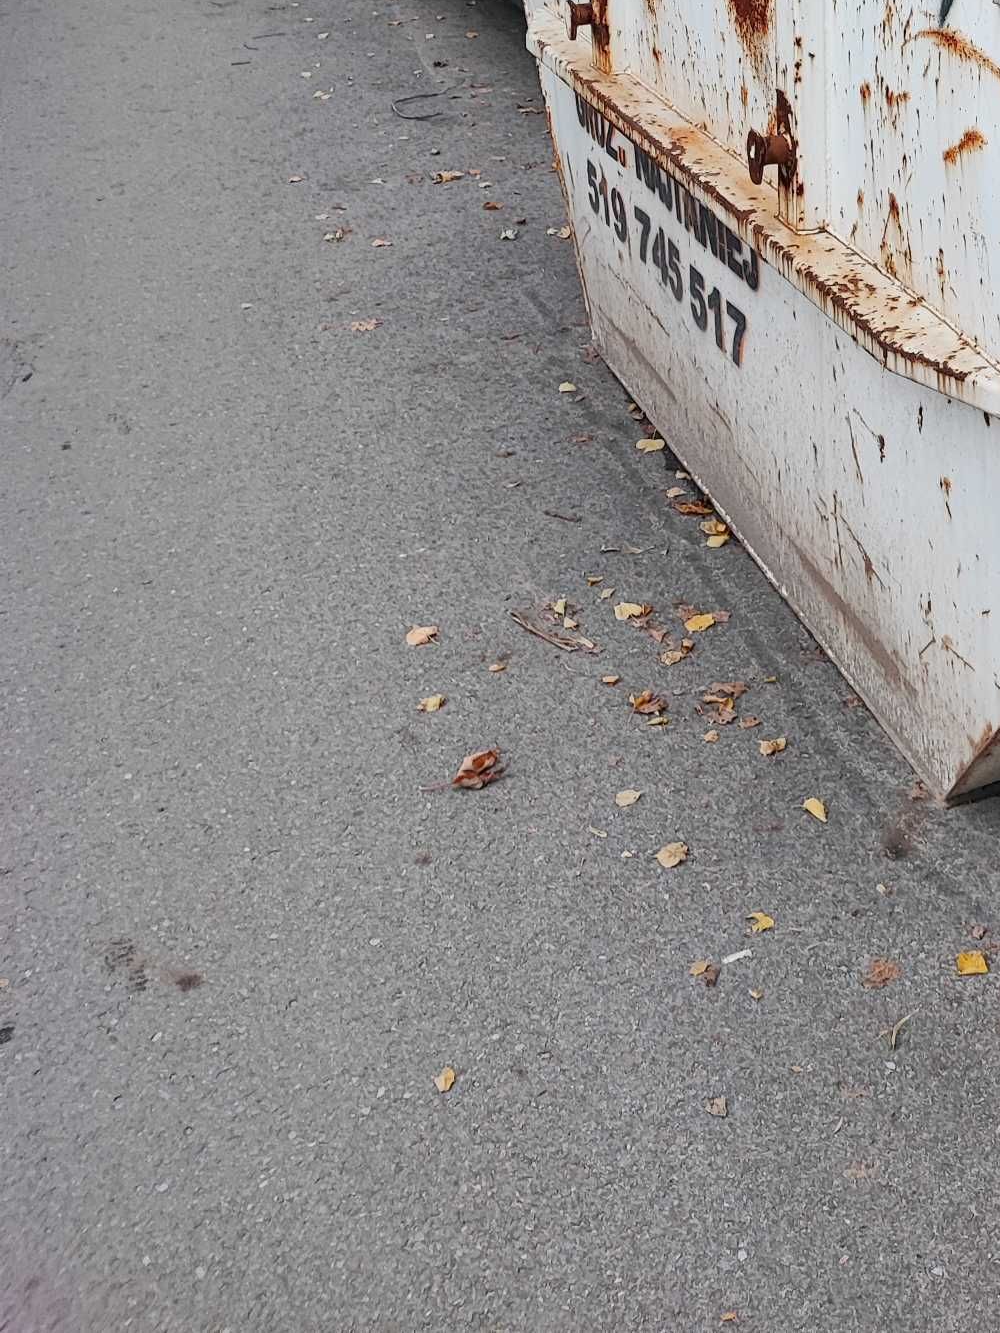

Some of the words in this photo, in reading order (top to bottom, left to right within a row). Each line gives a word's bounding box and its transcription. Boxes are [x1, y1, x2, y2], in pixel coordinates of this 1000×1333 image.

[587, 158, 627, 243] 519
[634, 206, 683, 302] 745
[690, 265, 746, 367] 517
